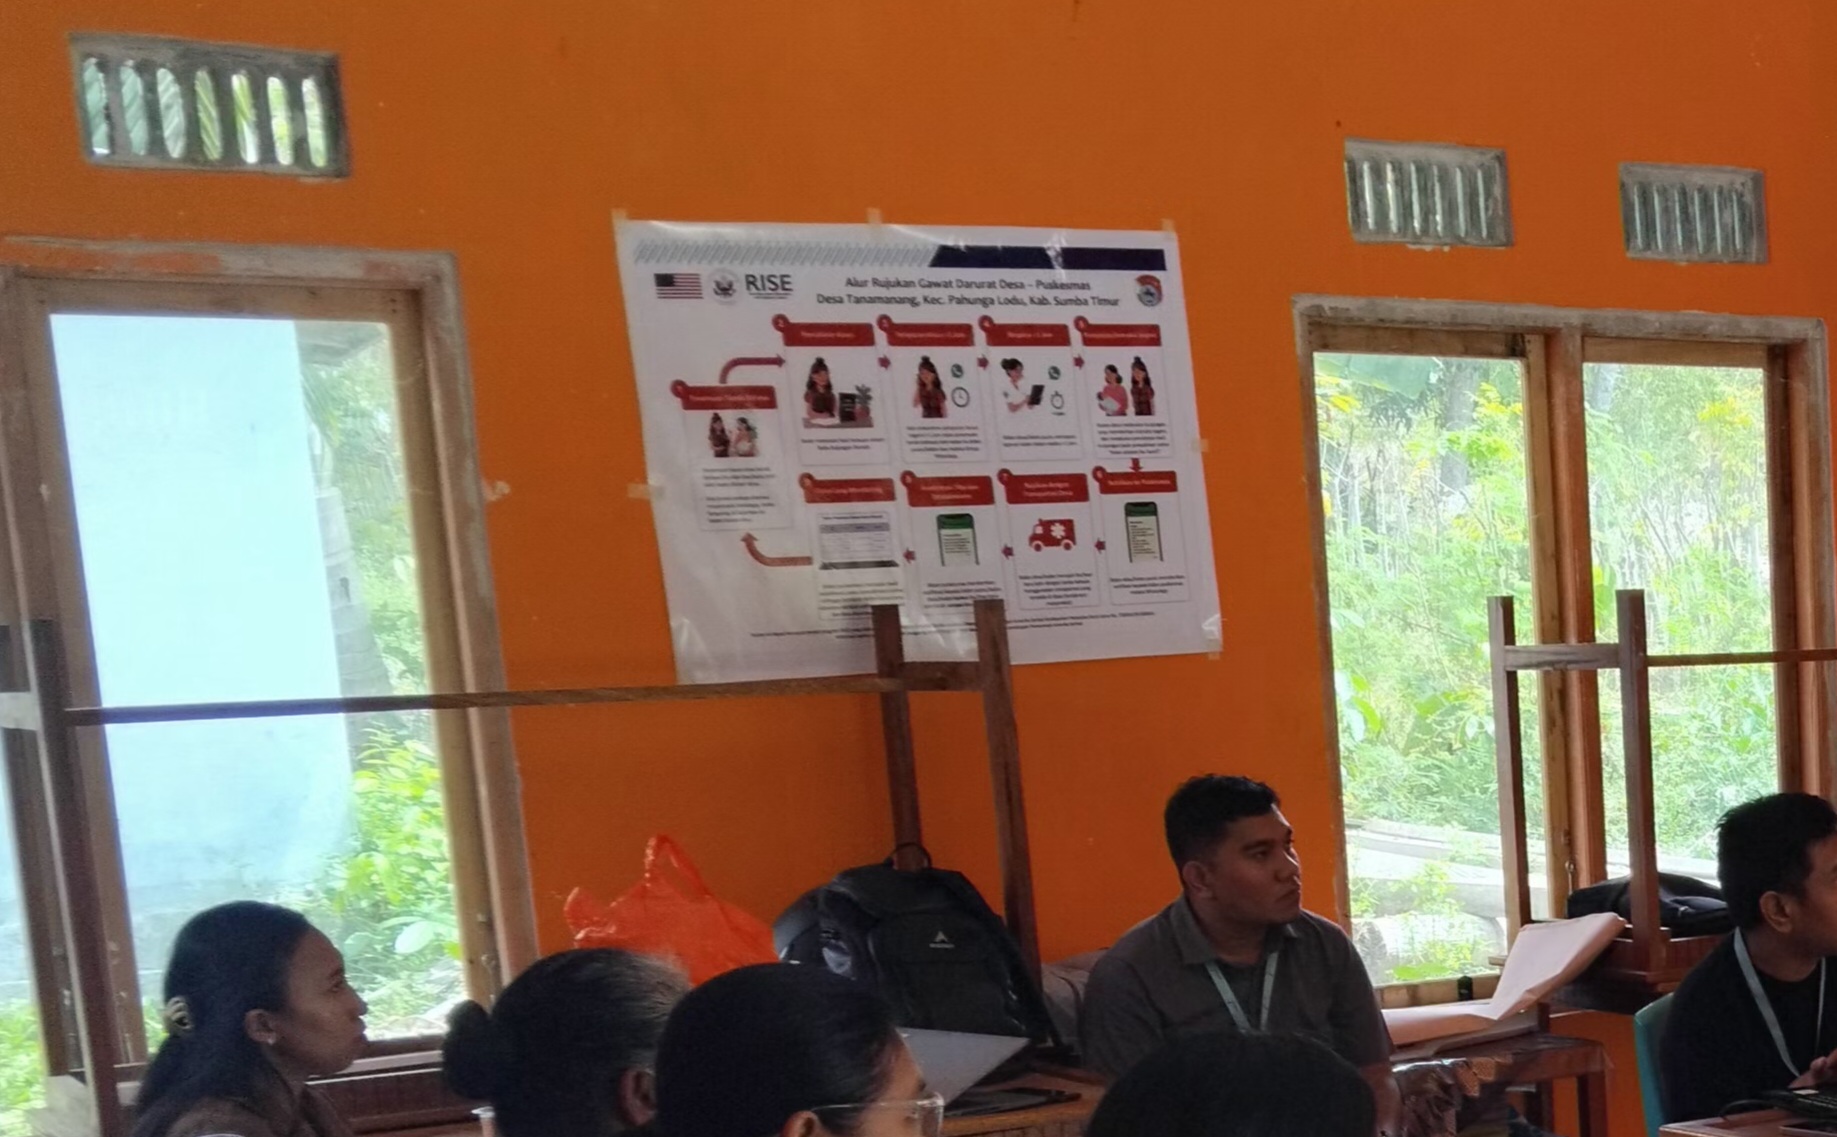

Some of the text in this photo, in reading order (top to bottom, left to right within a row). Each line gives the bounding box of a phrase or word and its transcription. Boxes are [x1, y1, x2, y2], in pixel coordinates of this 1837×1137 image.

[745, 274, 793, 291] RISE
[845, 278, 867, 287] Alur
[872, 278, 916, 290] Rujukan
[918, 279, 953, 289] Gawat
[956, 279, 996, 289] Darurat
[999, 280, 1024, 289] Desa
[1036, 280, 1090, 290] Puskesmas
[817, 295, 844, 304] Desa
[949, 295, 994, 307] Pahunga
[1054, 296, 1088, 306] Sumba
[1091, 296, 1119, 306] Timur
